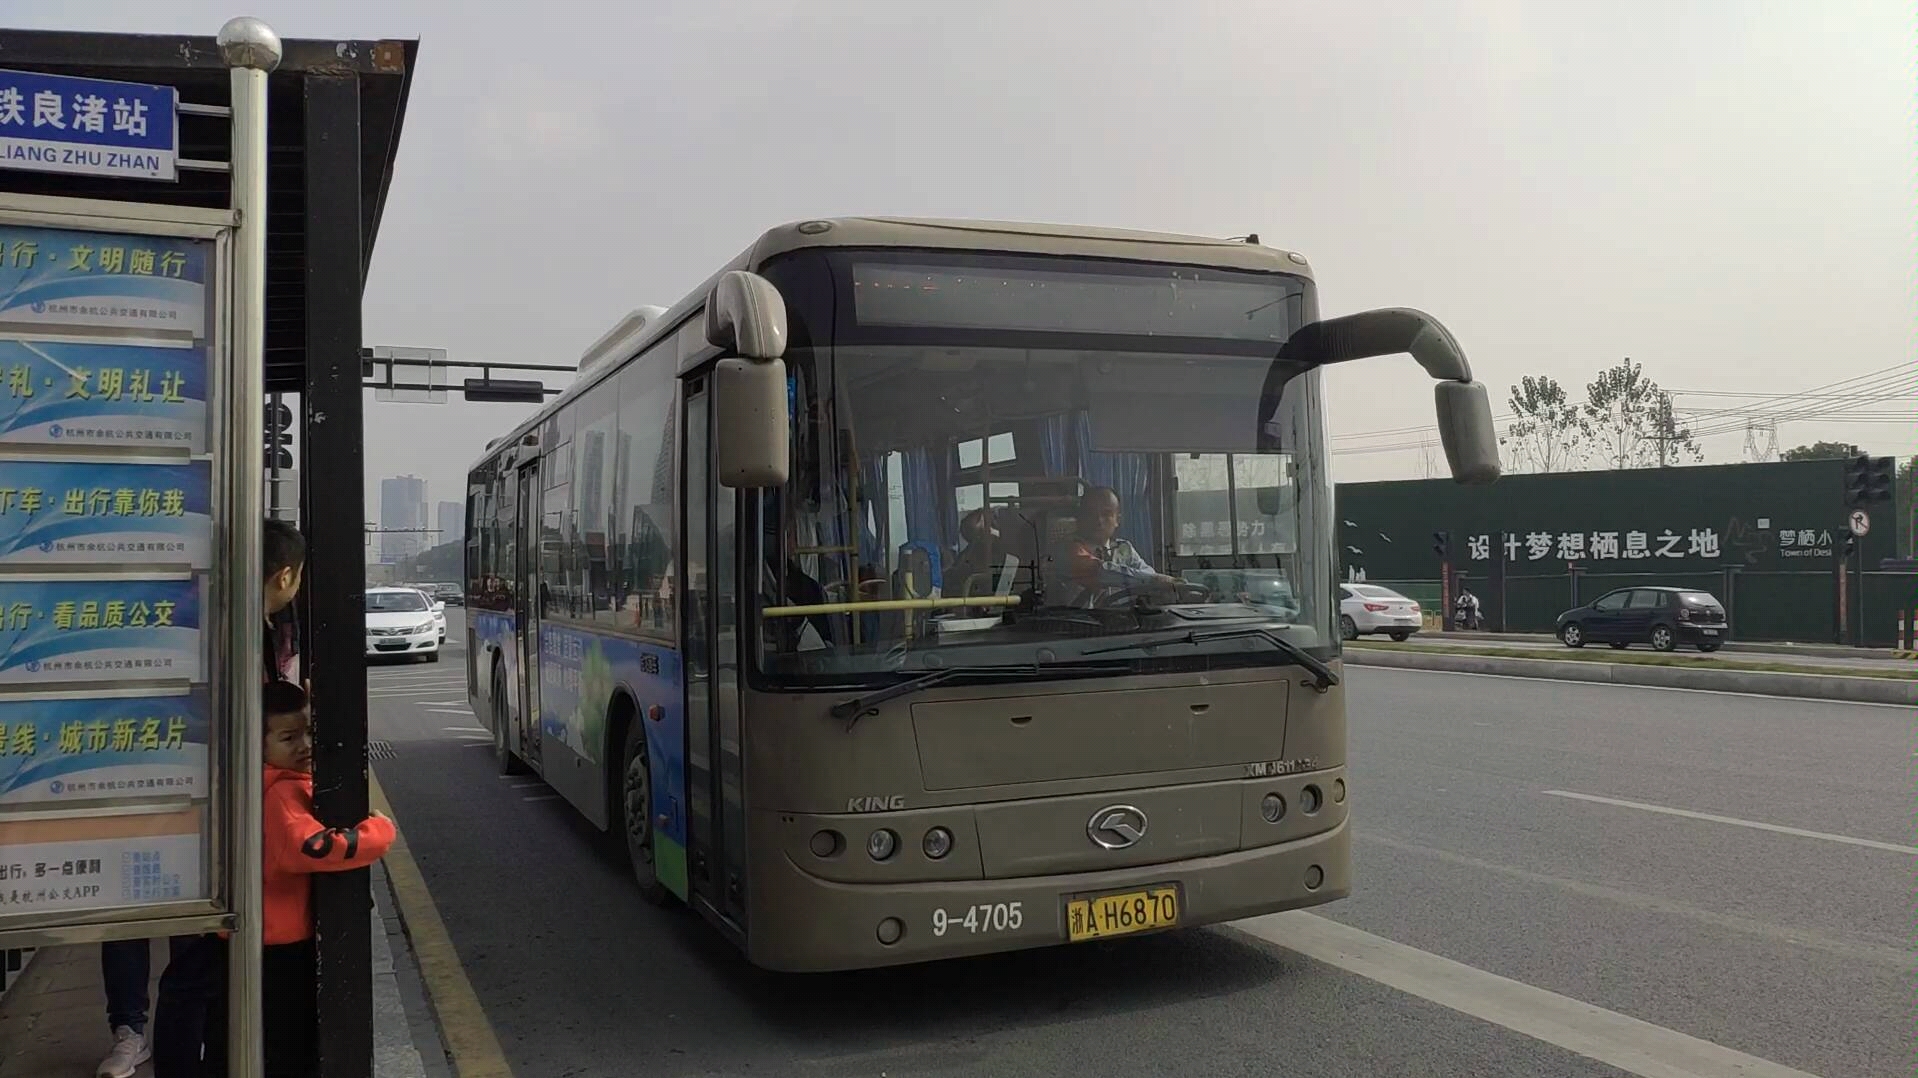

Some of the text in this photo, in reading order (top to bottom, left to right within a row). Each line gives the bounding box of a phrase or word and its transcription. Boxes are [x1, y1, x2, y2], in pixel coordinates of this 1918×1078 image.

[62, 148, 102, 167] ZHU
[106, 152, 160, 171] ZHAN
[0, 239, 187, 278] 行·文明随行
[0, 364, 186, 402] 礼·文明礼让
[1467, 528, 1721, 561] 设计梦想栖息之地
[1780, 549, 1803, 557] Town
[1803, 548, 1813, 557] of
[0, 600, 176, 630] 行·看品质公交
[848, 795, 905, 812] KING
[933, 901, 1024, 937] 9-4705
